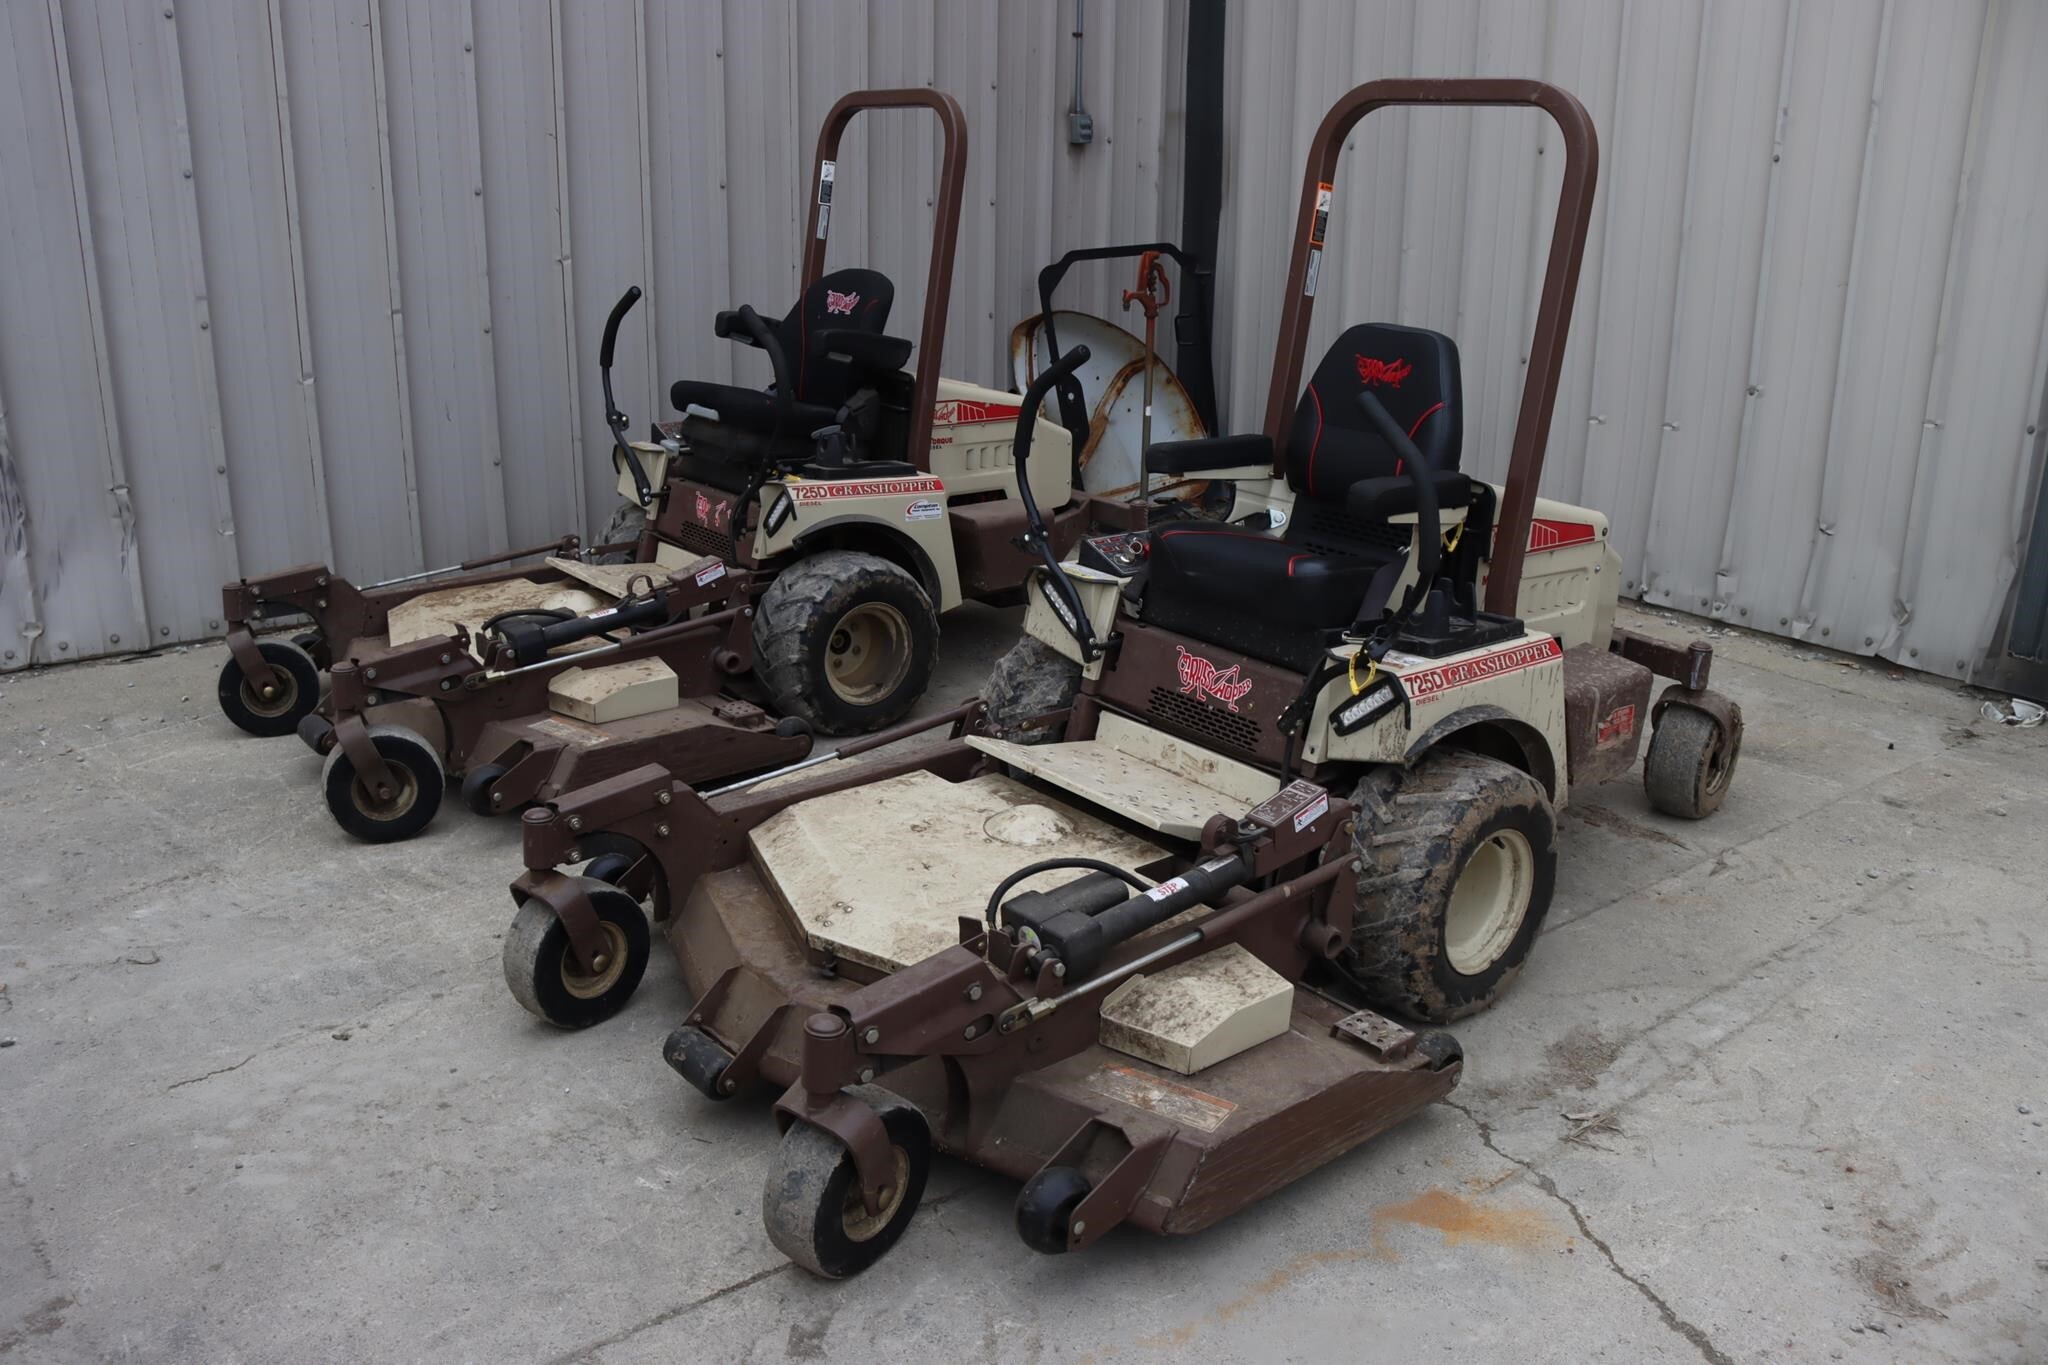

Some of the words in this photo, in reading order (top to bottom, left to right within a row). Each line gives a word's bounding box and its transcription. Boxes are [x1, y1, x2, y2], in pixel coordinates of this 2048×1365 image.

[792, 487, 828, 499] 725D
[833, 481, 936, 496] GRASSHOPPER
[1404, 671, 1444, 696] 725D
[1448, 642, 1553, 684] GRASSHOPPER
[1415, 695, 1441, 706] DIESEL
